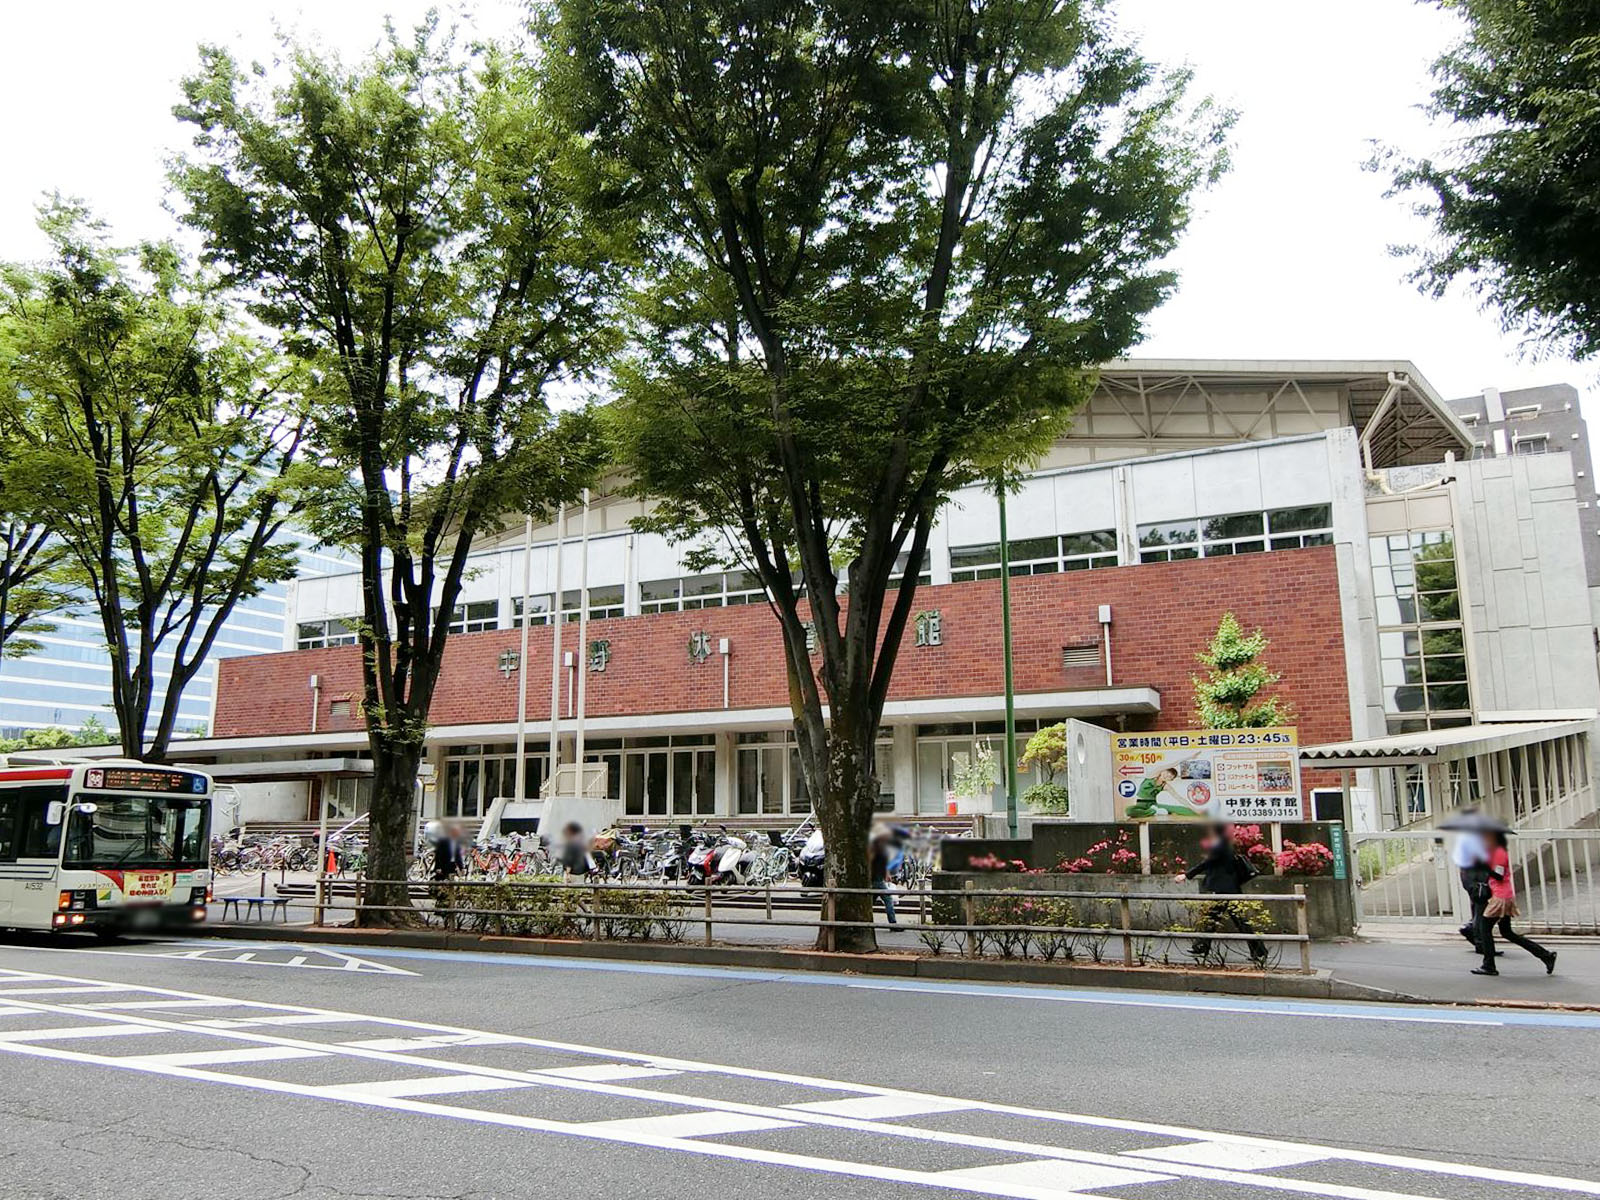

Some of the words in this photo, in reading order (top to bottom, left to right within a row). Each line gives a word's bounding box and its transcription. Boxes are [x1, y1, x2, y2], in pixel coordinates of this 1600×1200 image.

[1225, 797, 1297, 807] 中野体育館
